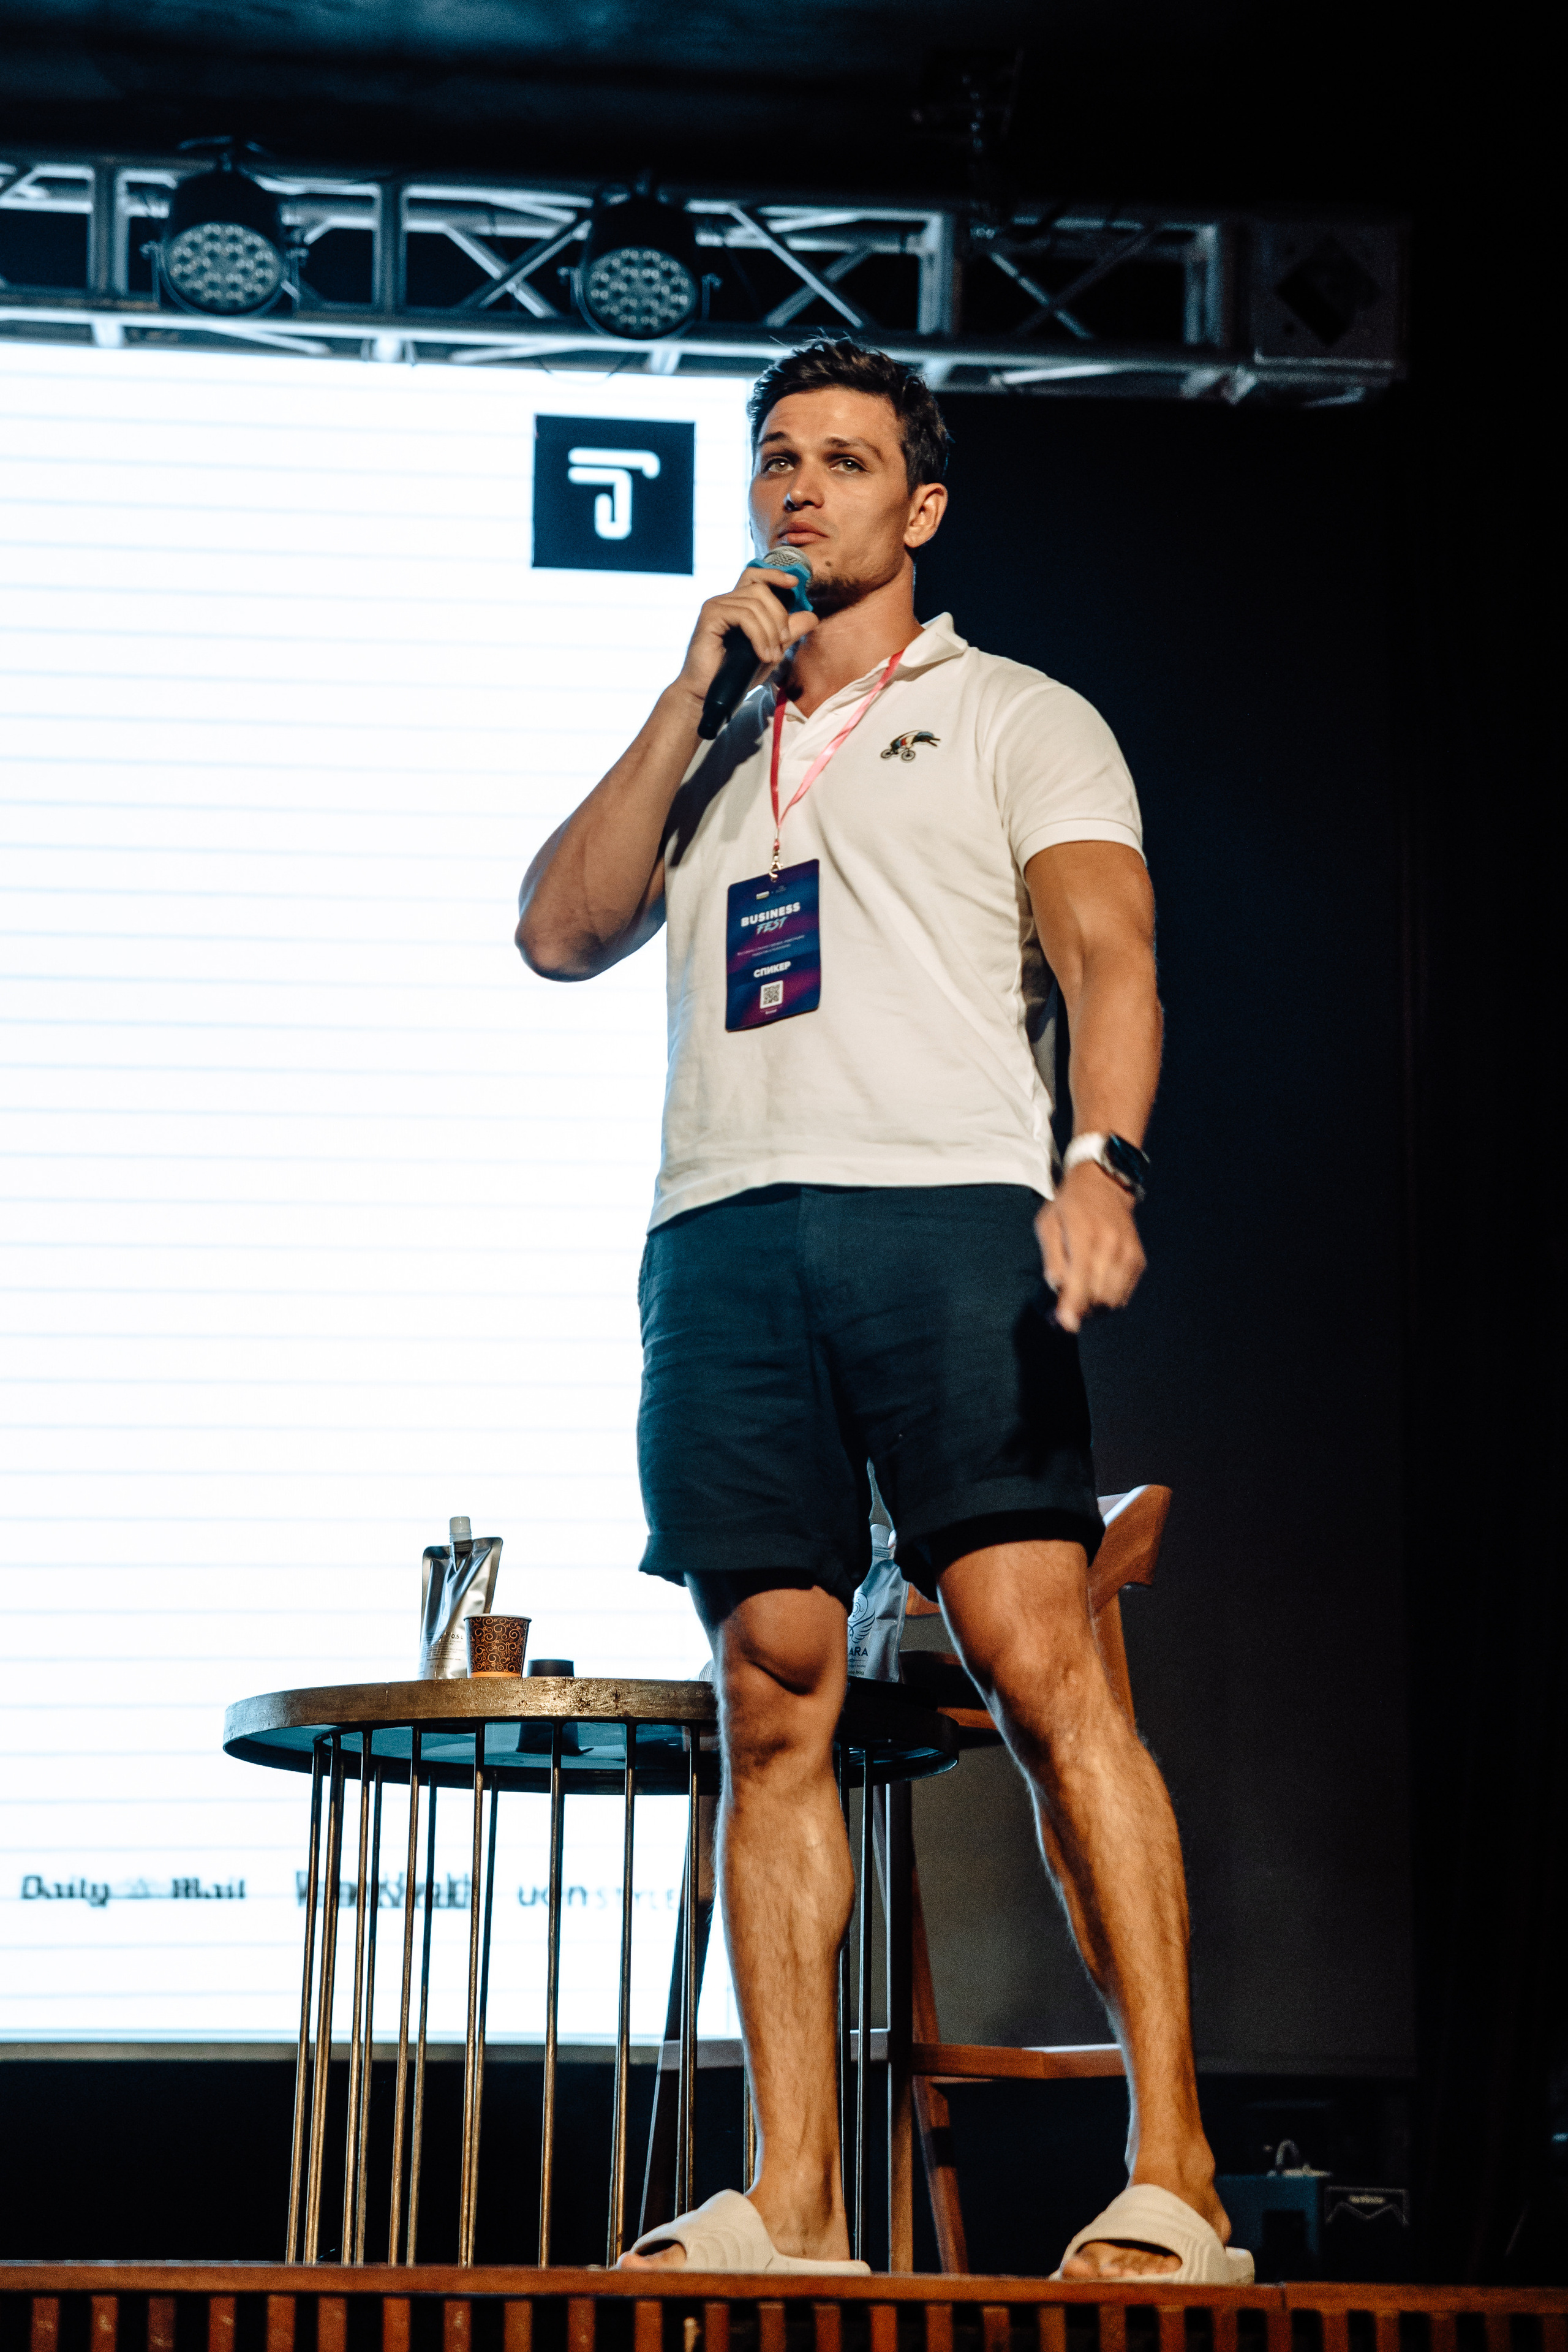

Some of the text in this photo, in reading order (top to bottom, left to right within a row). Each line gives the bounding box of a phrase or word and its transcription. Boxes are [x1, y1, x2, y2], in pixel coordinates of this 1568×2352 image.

[741, 902, 801, 927] BUSINESS
[756, 916, 788, 935] FEST
[753, 960, 791, 978] СПИКЕР
[21, 1875, 246, 1907] Daily Mail
